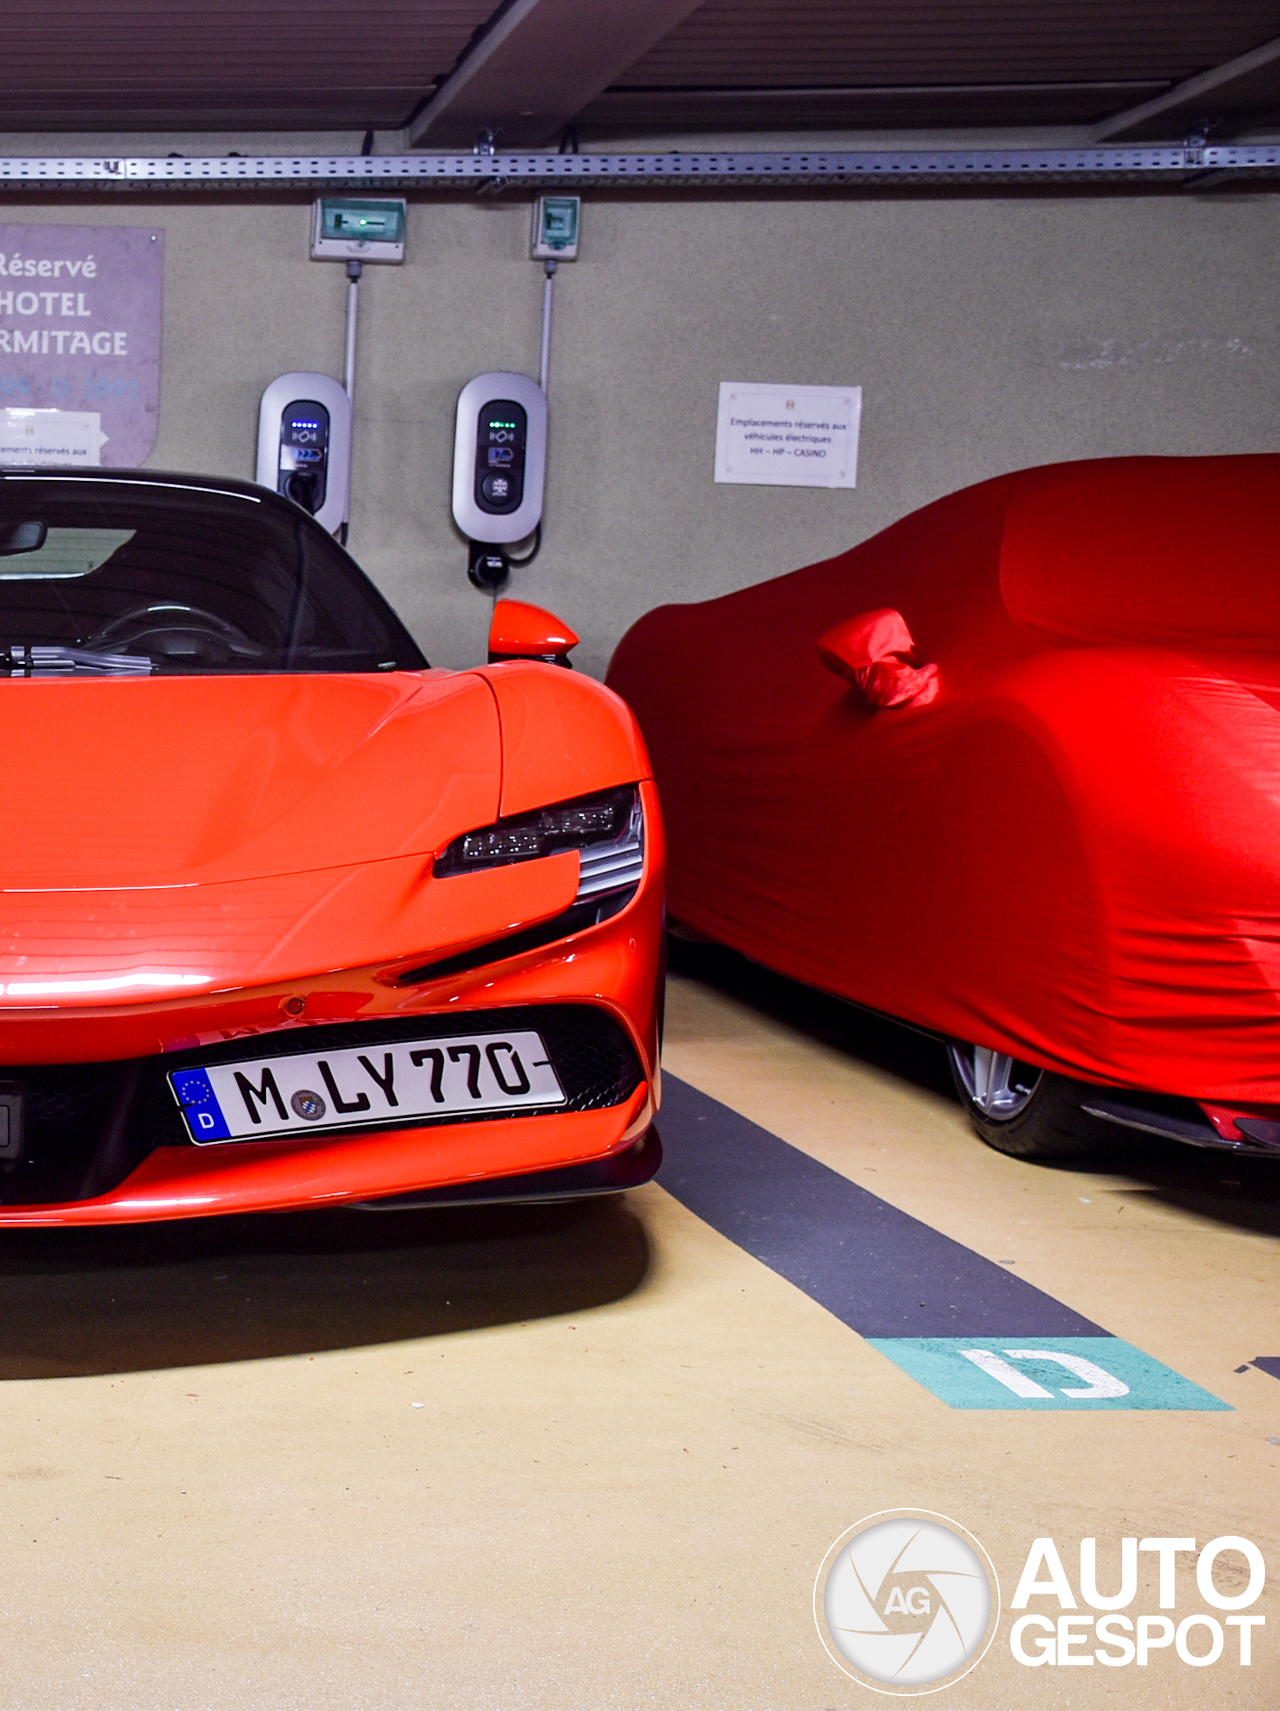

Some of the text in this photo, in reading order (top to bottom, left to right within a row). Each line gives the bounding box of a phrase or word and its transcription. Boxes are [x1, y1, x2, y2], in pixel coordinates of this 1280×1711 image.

[730, 417, 792, 429] Emplacements
[794, 420, 829, 430] réservés
[744, 432, 831, 444] véhicules électriques
[72, 448, 87, 456] aux
[794, 448, 826, 458] CASINO
[234, 1067, 290, 1125] M
[318, 1052, 399, 1114] LY
[410, 1042, 531, 1104] 770
[198, 1112, 215, 1129] D
